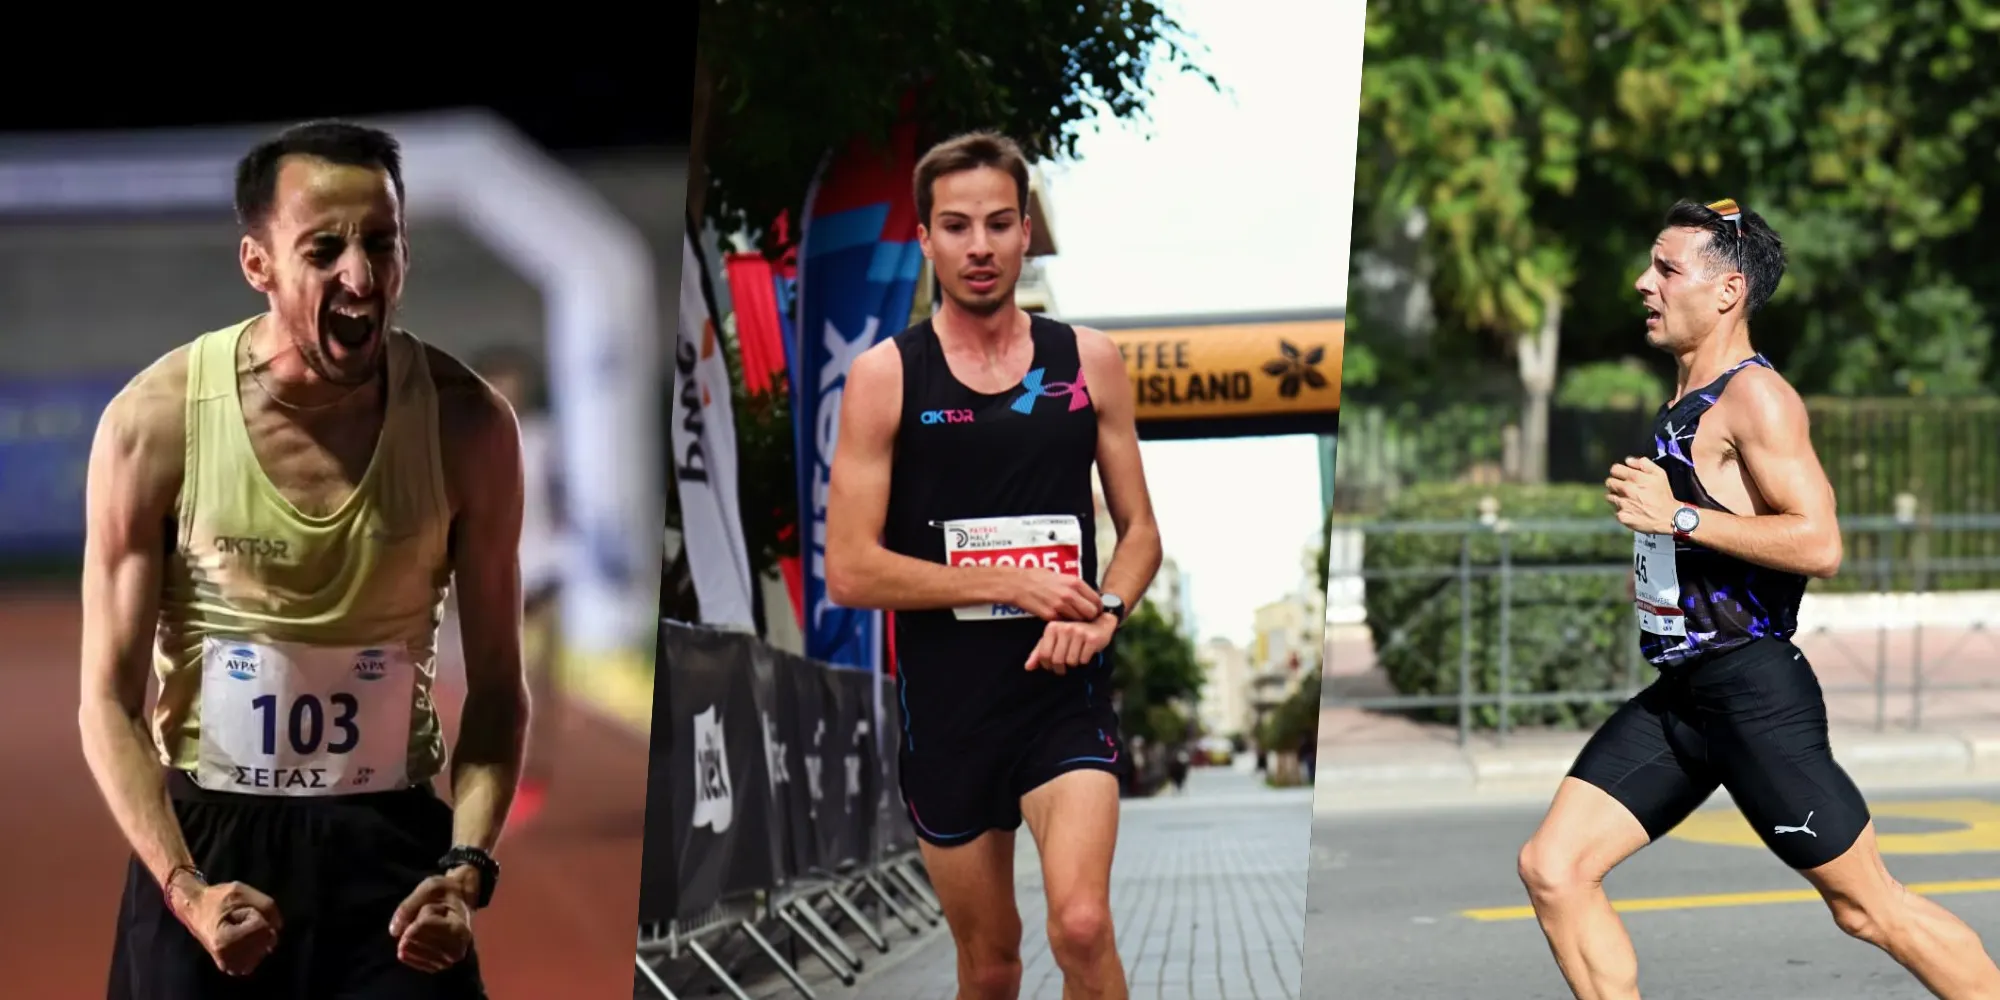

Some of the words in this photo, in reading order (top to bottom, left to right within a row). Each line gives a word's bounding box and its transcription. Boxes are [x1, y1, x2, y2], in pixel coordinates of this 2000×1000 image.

[1137, 371, 1252, 405] ISLAND
[252, 693, 360, 756] 103
[235, 765, 328, 789] ΣΕΓΑΣ
